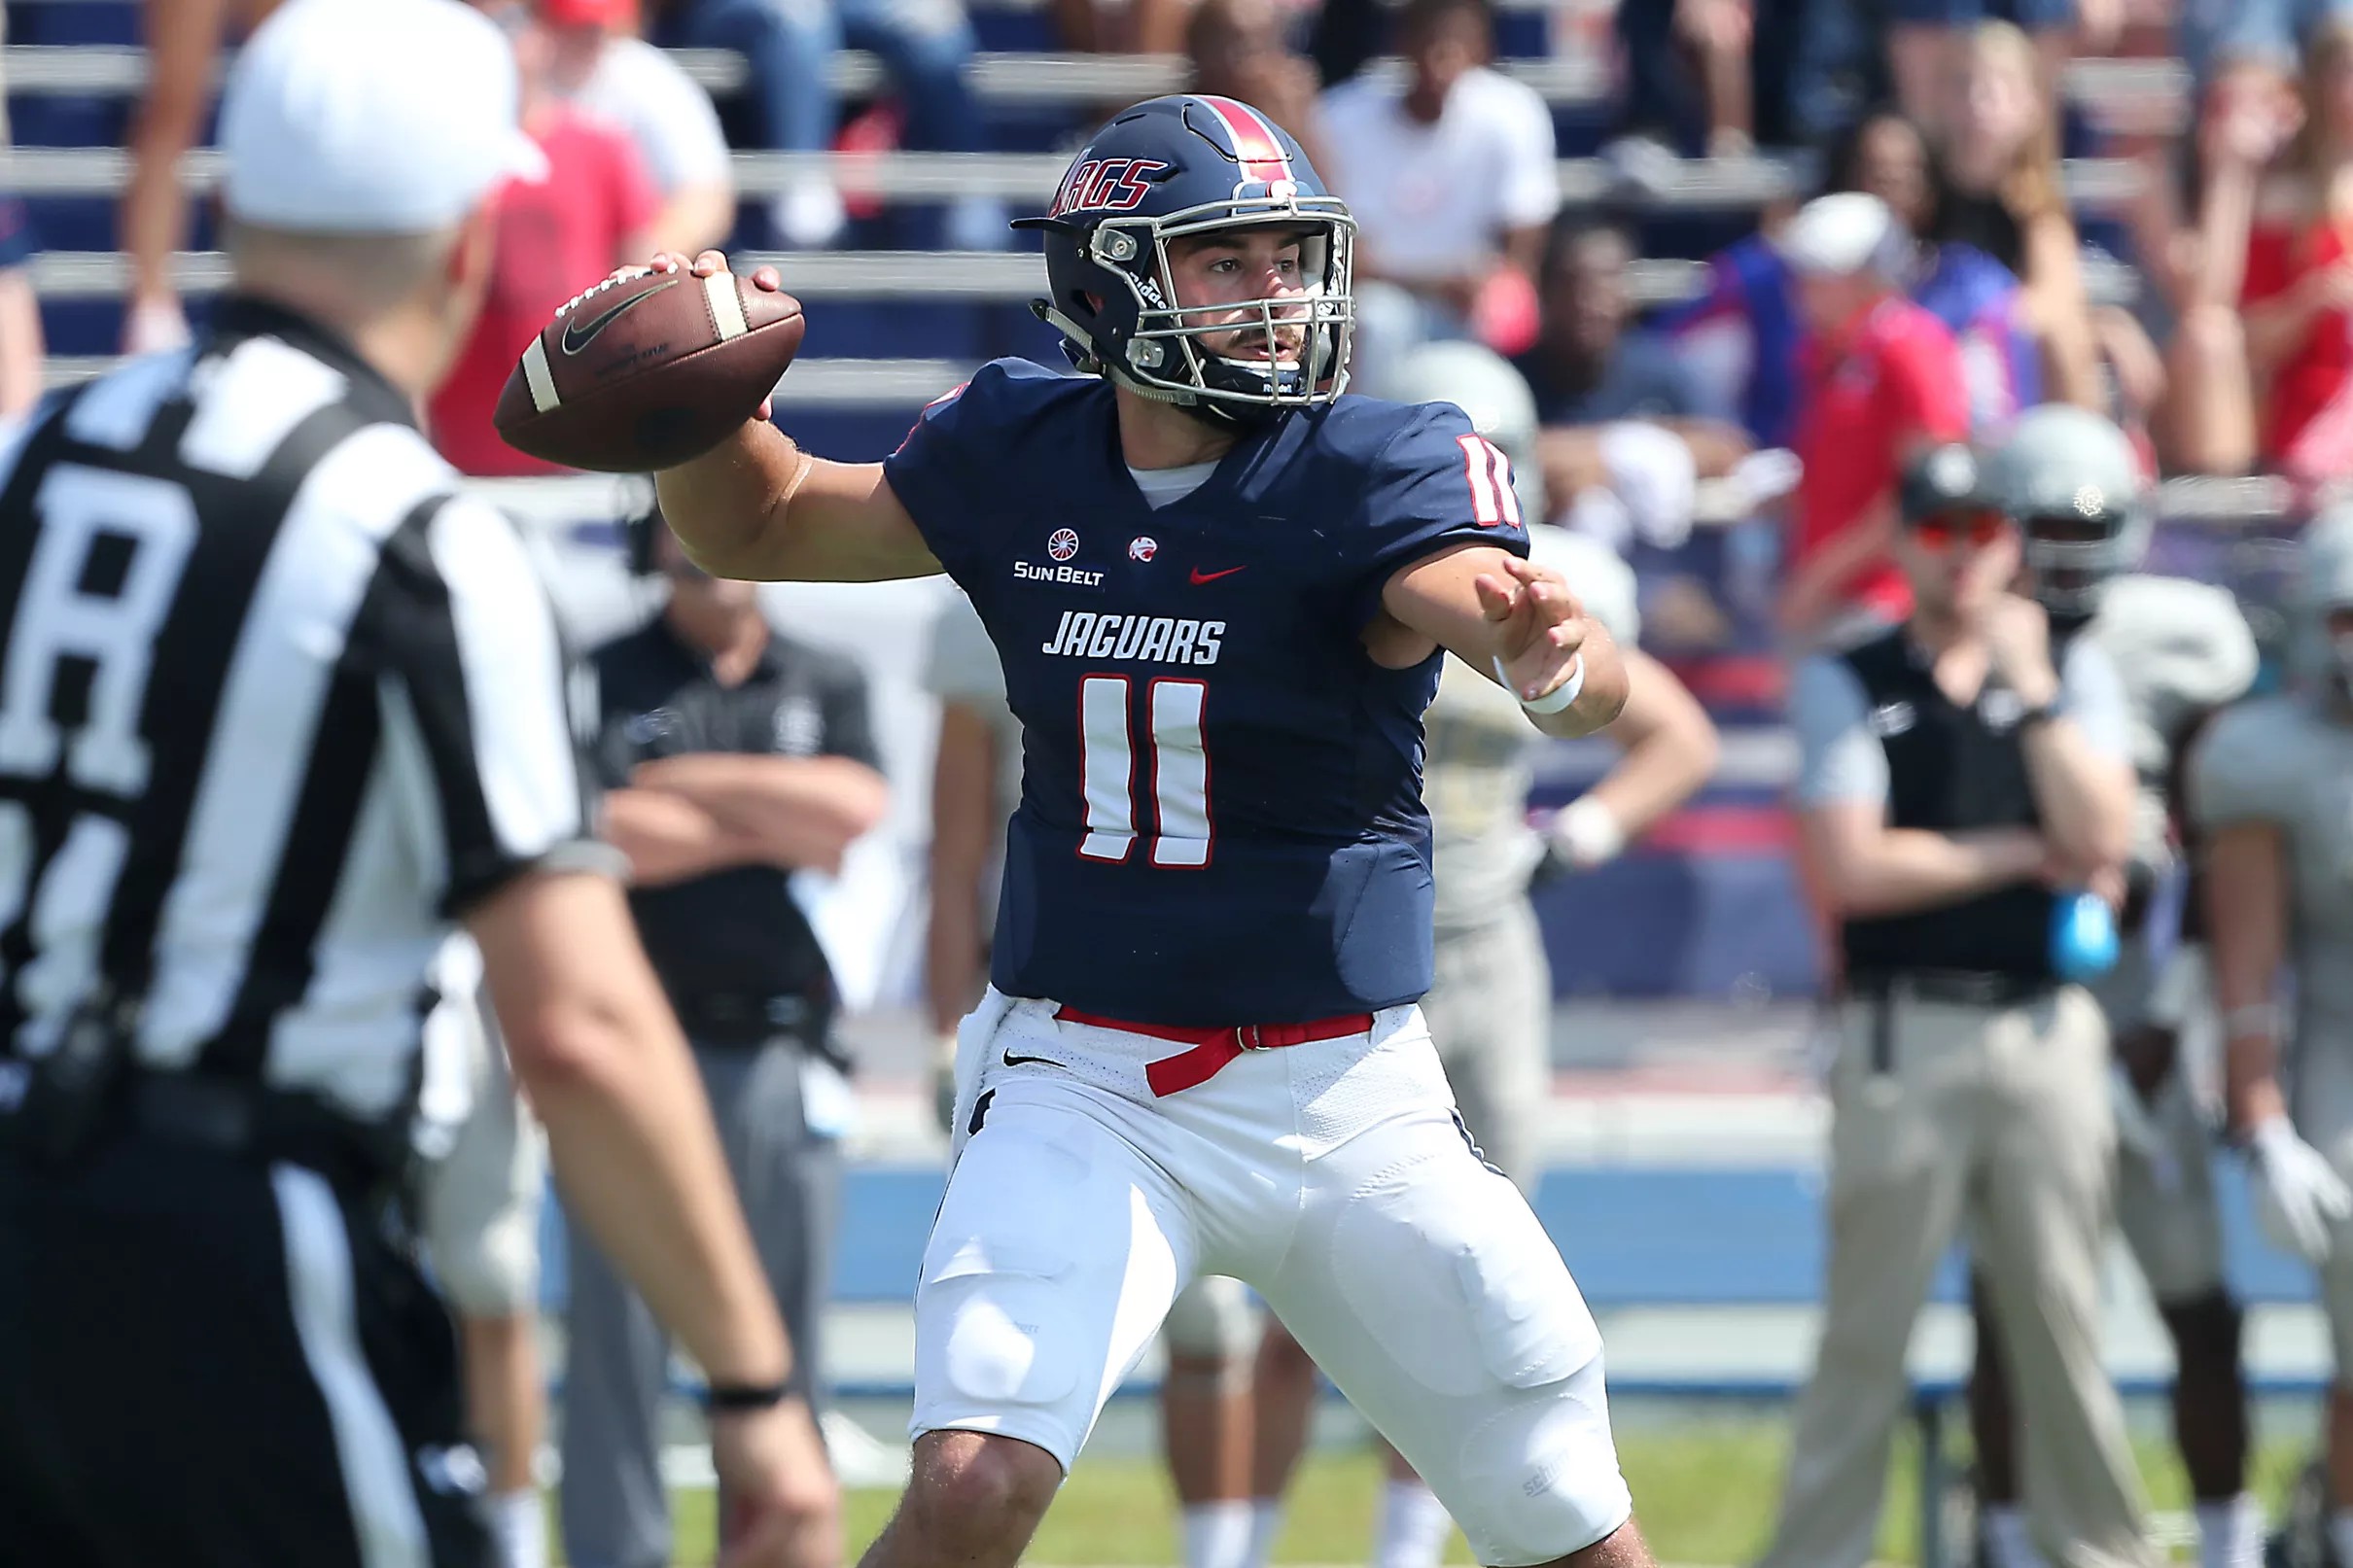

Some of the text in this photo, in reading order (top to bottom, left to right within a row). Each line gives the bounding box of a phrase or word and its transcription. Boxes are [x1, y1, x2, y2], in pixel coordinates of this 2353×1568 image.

[1456, 433, 1521, 528] 11
[1013, 561, 1105, 586] SUN BELT
[1041, 610, 1226, 665] JAGUARS
[1075, 672, 1212, 870] 11
